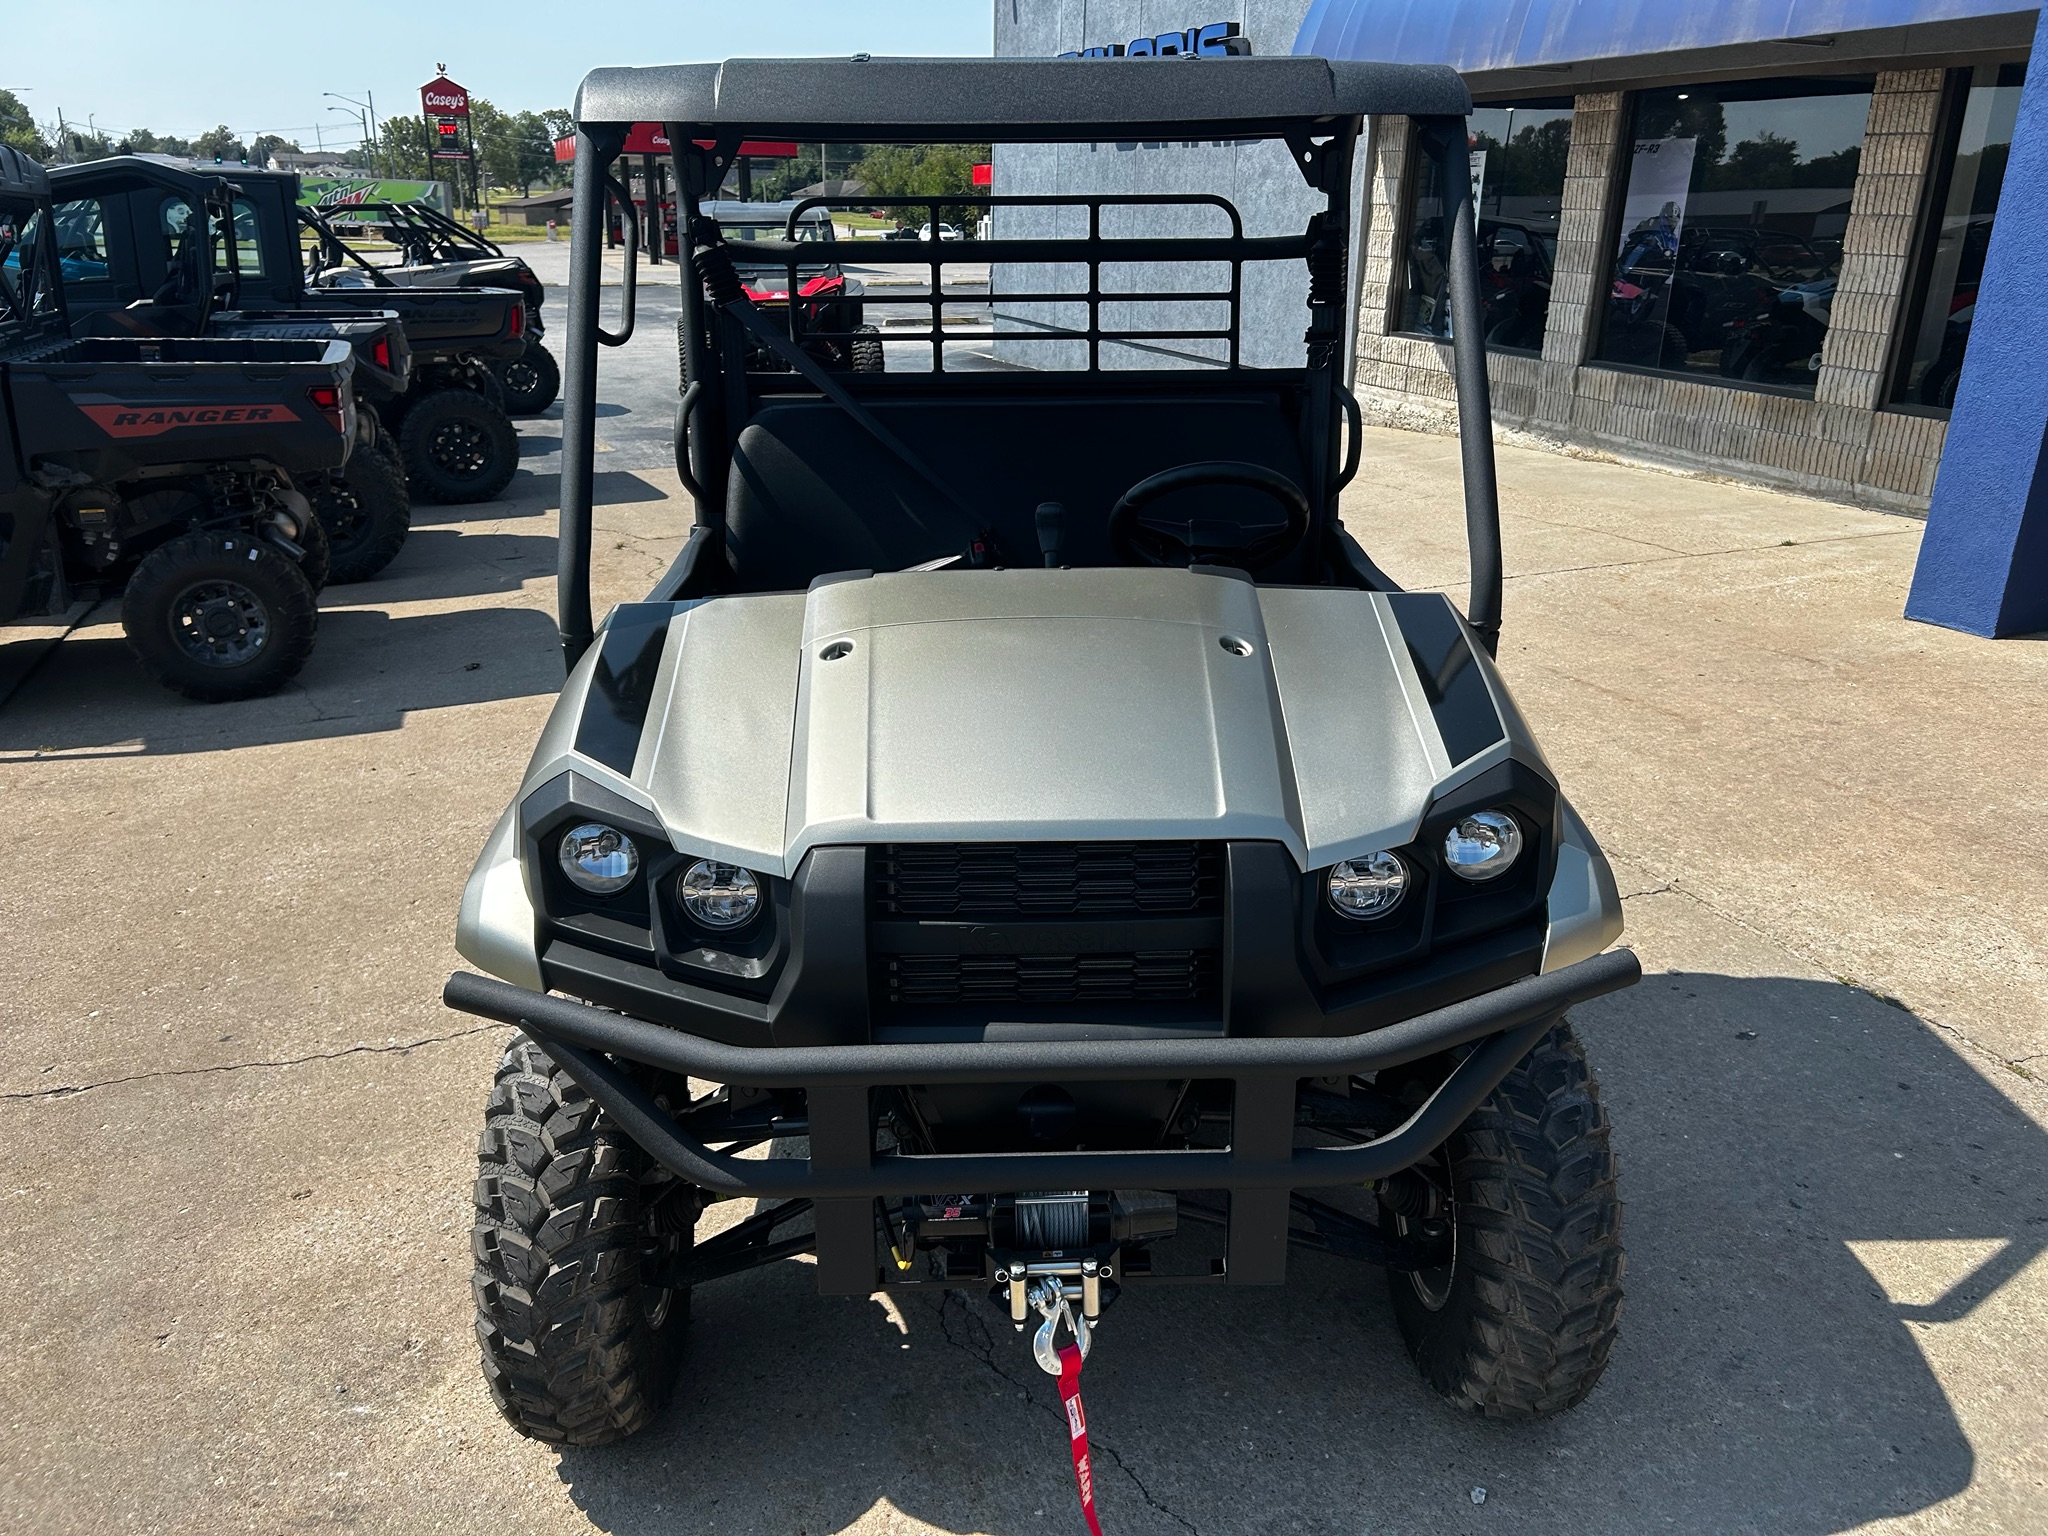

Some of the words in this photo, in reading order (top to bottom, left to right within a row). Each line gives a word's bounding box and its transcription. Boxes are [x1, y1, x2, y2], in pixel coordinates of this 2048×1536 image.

[425, 92, 465, 109] Casey's
[1633, 144, 1661, 154] ZF-R3
[399, 308, 480, 318] ANGER
[113, 408, 273, 426] RANGER
[959, 926, 1136, 952] Kawasaki
[930, 1194, 975, 1207] VRX
[943, 1207, 962, 1218] 35
[1076, 1453, 1092, 1507] WARN
